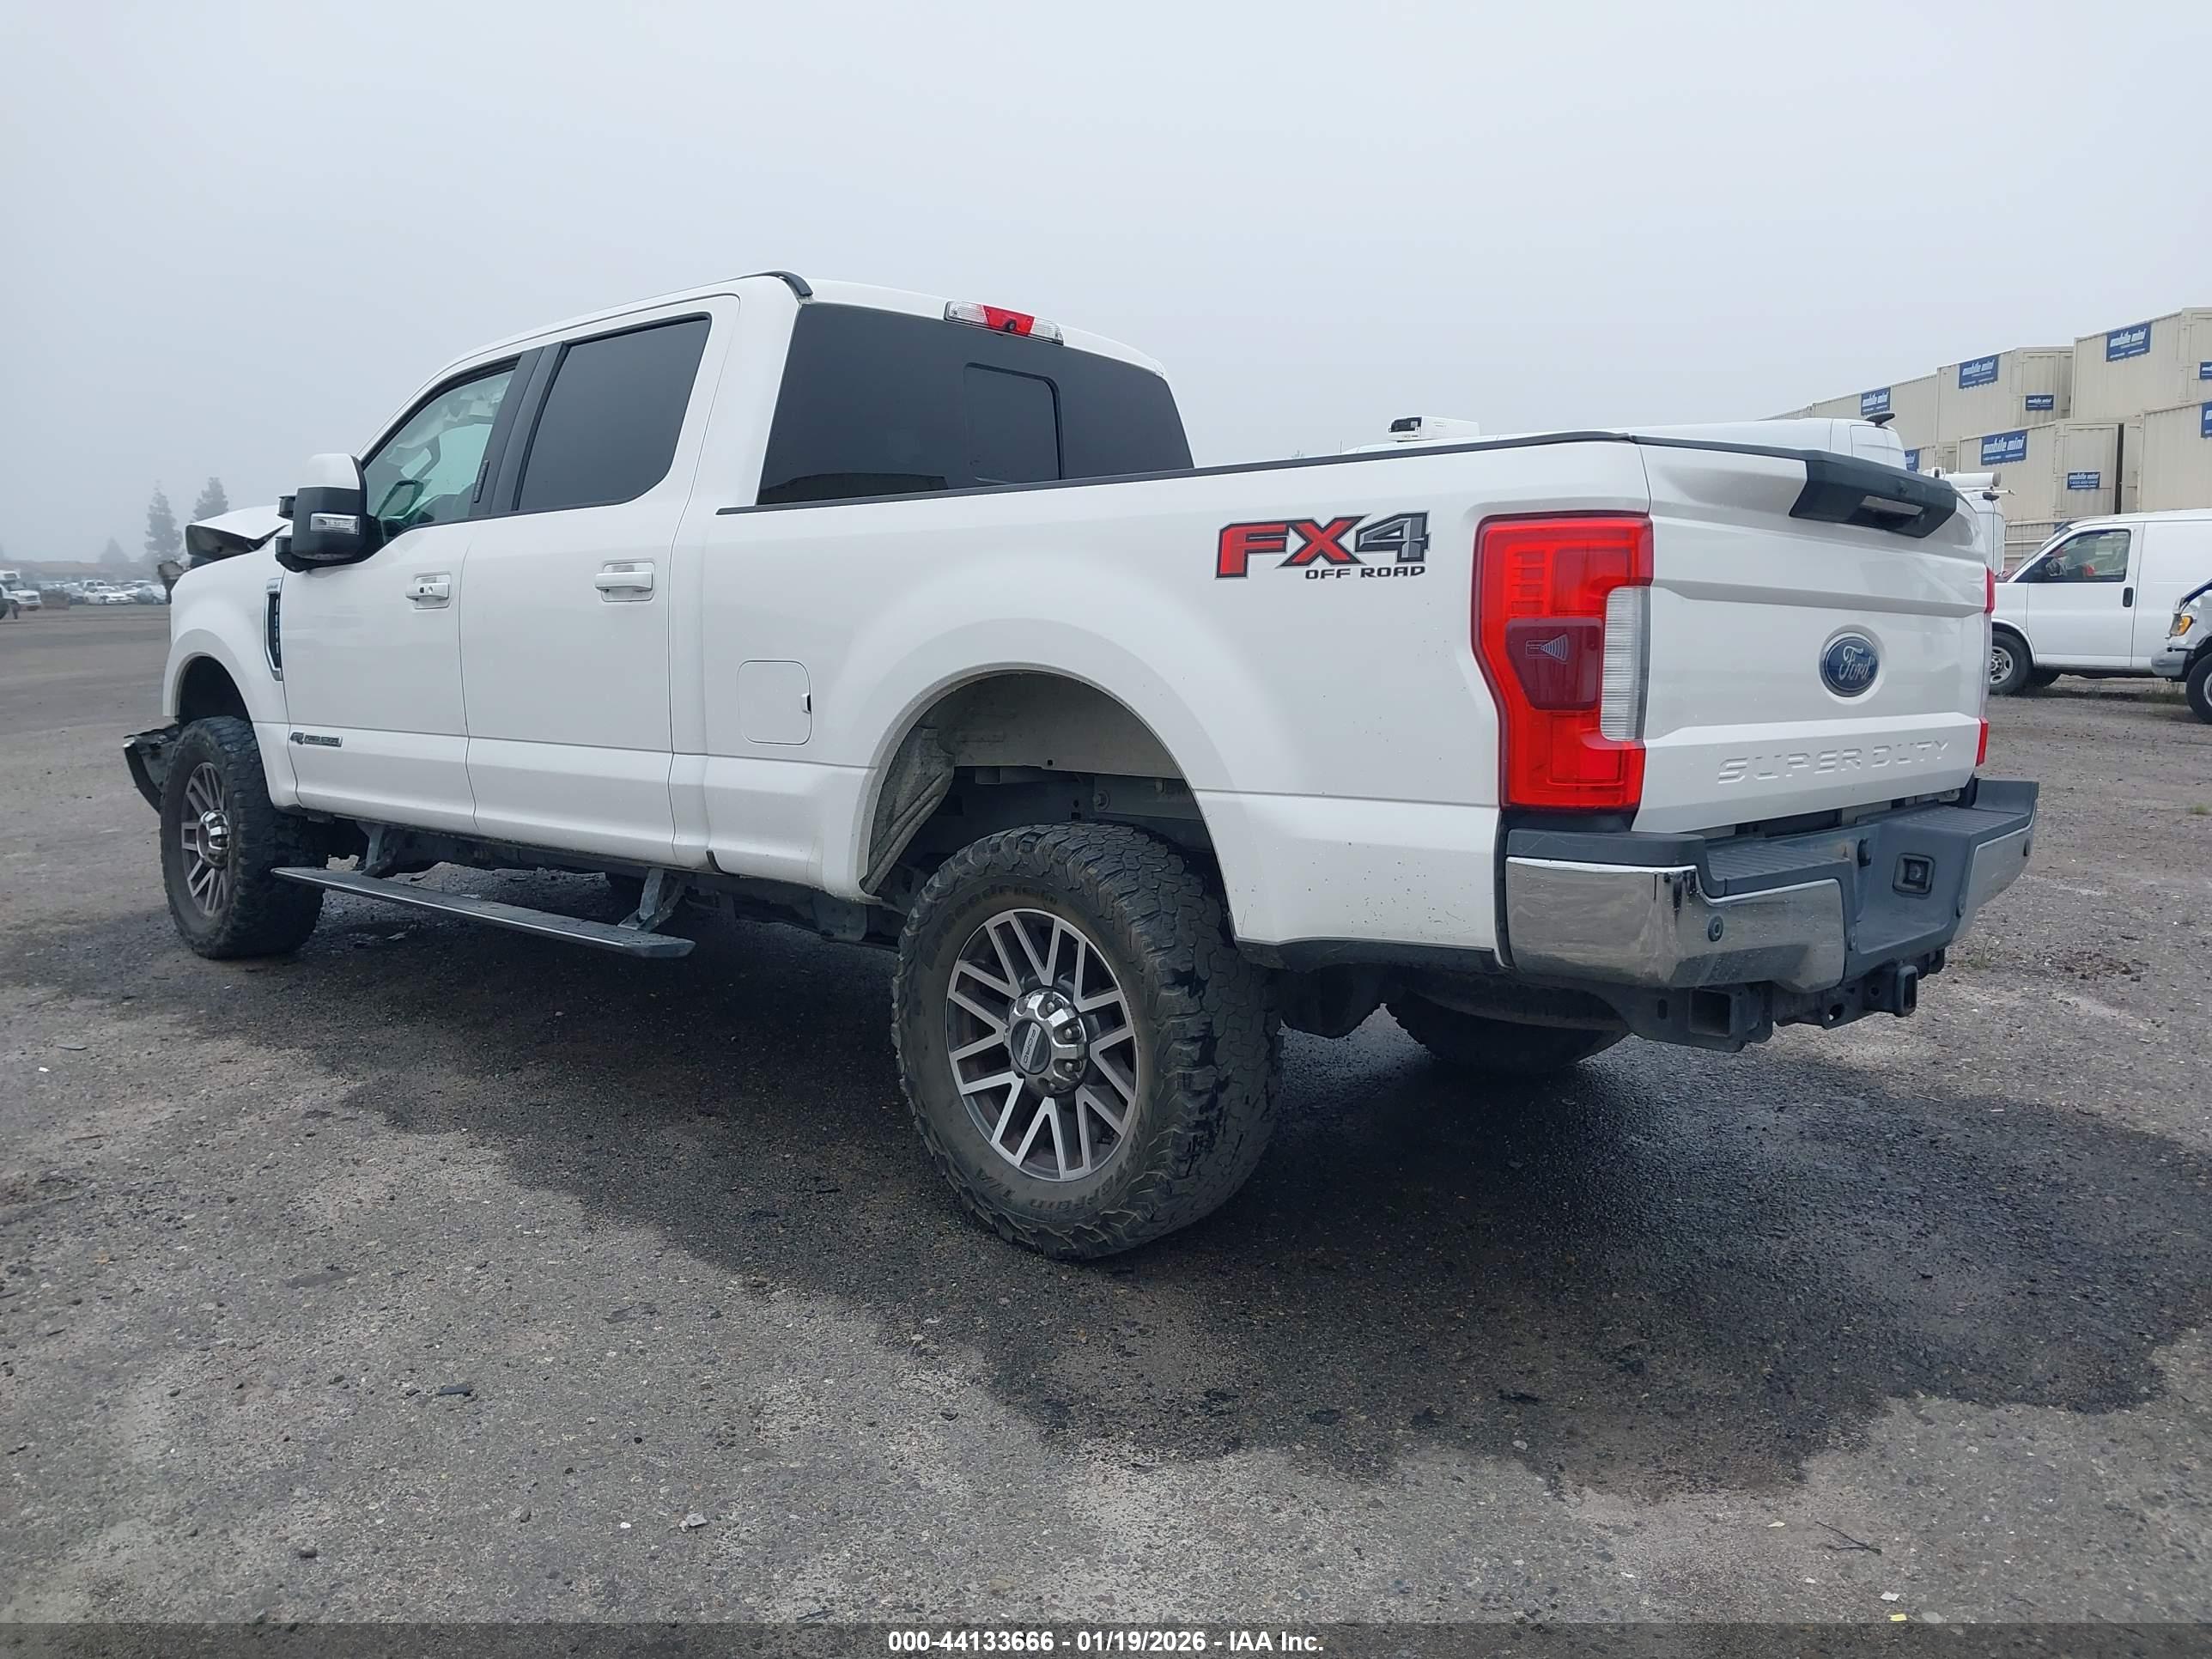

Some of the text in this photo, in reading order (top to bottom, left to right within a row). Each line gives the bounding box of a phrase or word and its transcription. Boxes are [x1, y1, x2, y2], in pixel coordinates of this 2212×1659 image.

[1983, 435, 2025, 454] mobile mini
[1214, 511, 1430, 579] FX4
[1305, 565, 1425, 580] OFF ROAD
[1838, 645, 1873, 681] Ford
[1717, 740, 1949, 784] SUPER DUTY
